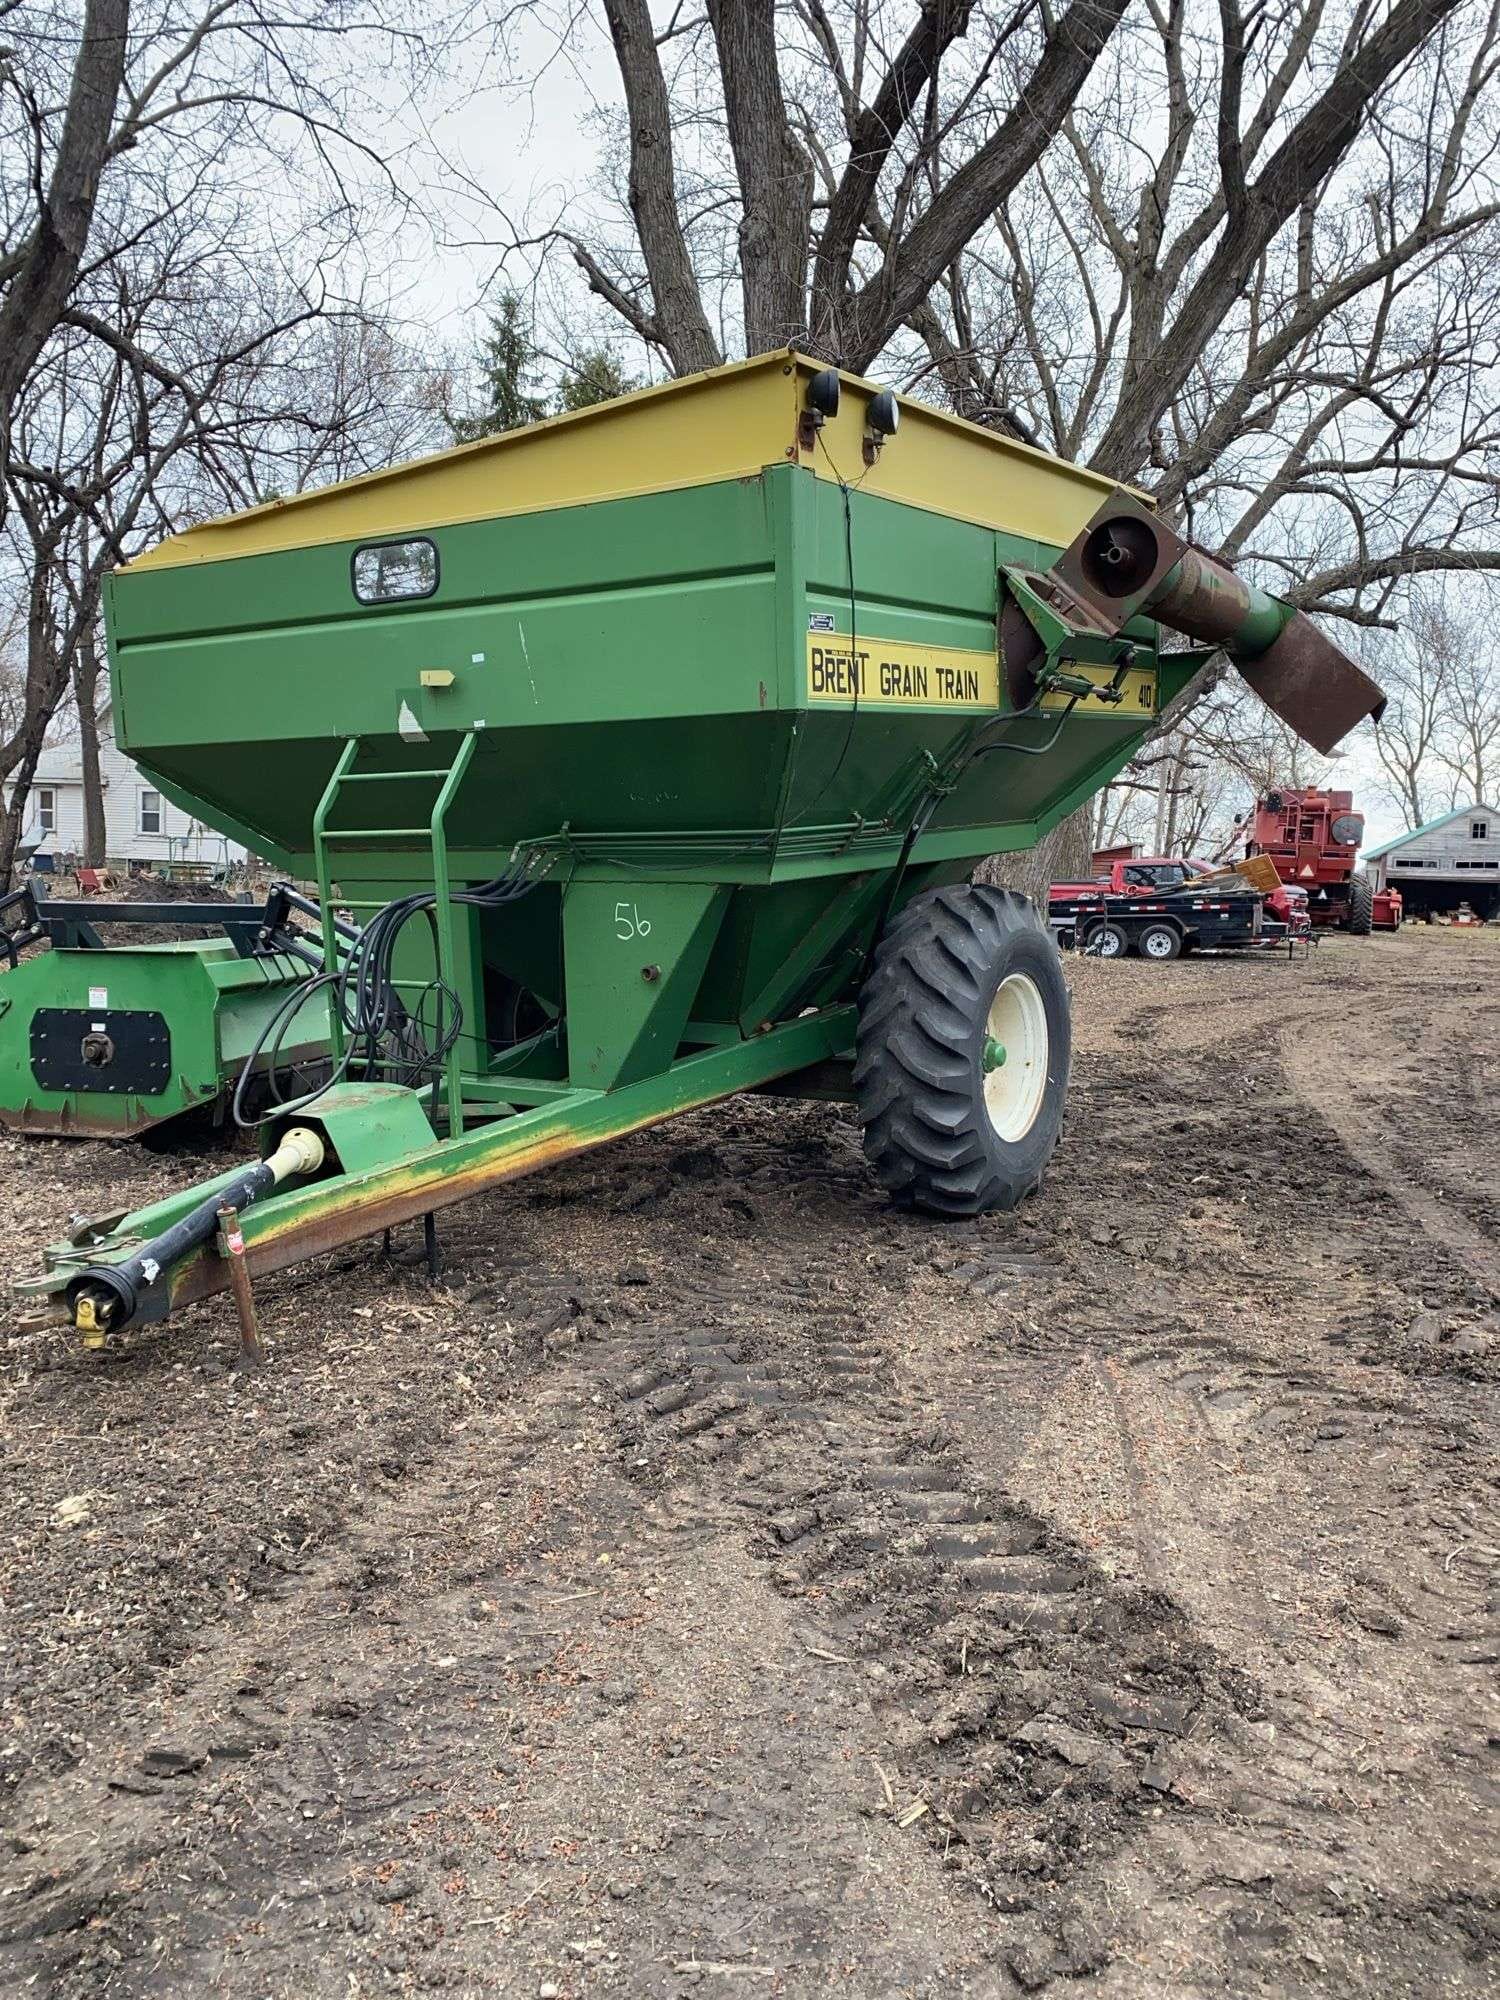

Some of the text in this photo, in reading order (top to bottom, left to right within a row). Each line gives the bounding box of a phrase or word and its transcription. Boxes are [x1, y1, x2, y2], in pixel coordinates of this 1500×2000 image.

[811, 647, 979, 700] BRENT GRAIN TRAIN
[1138, 684, 1152, 708] 410
[615, 902, 651, 940] 56
